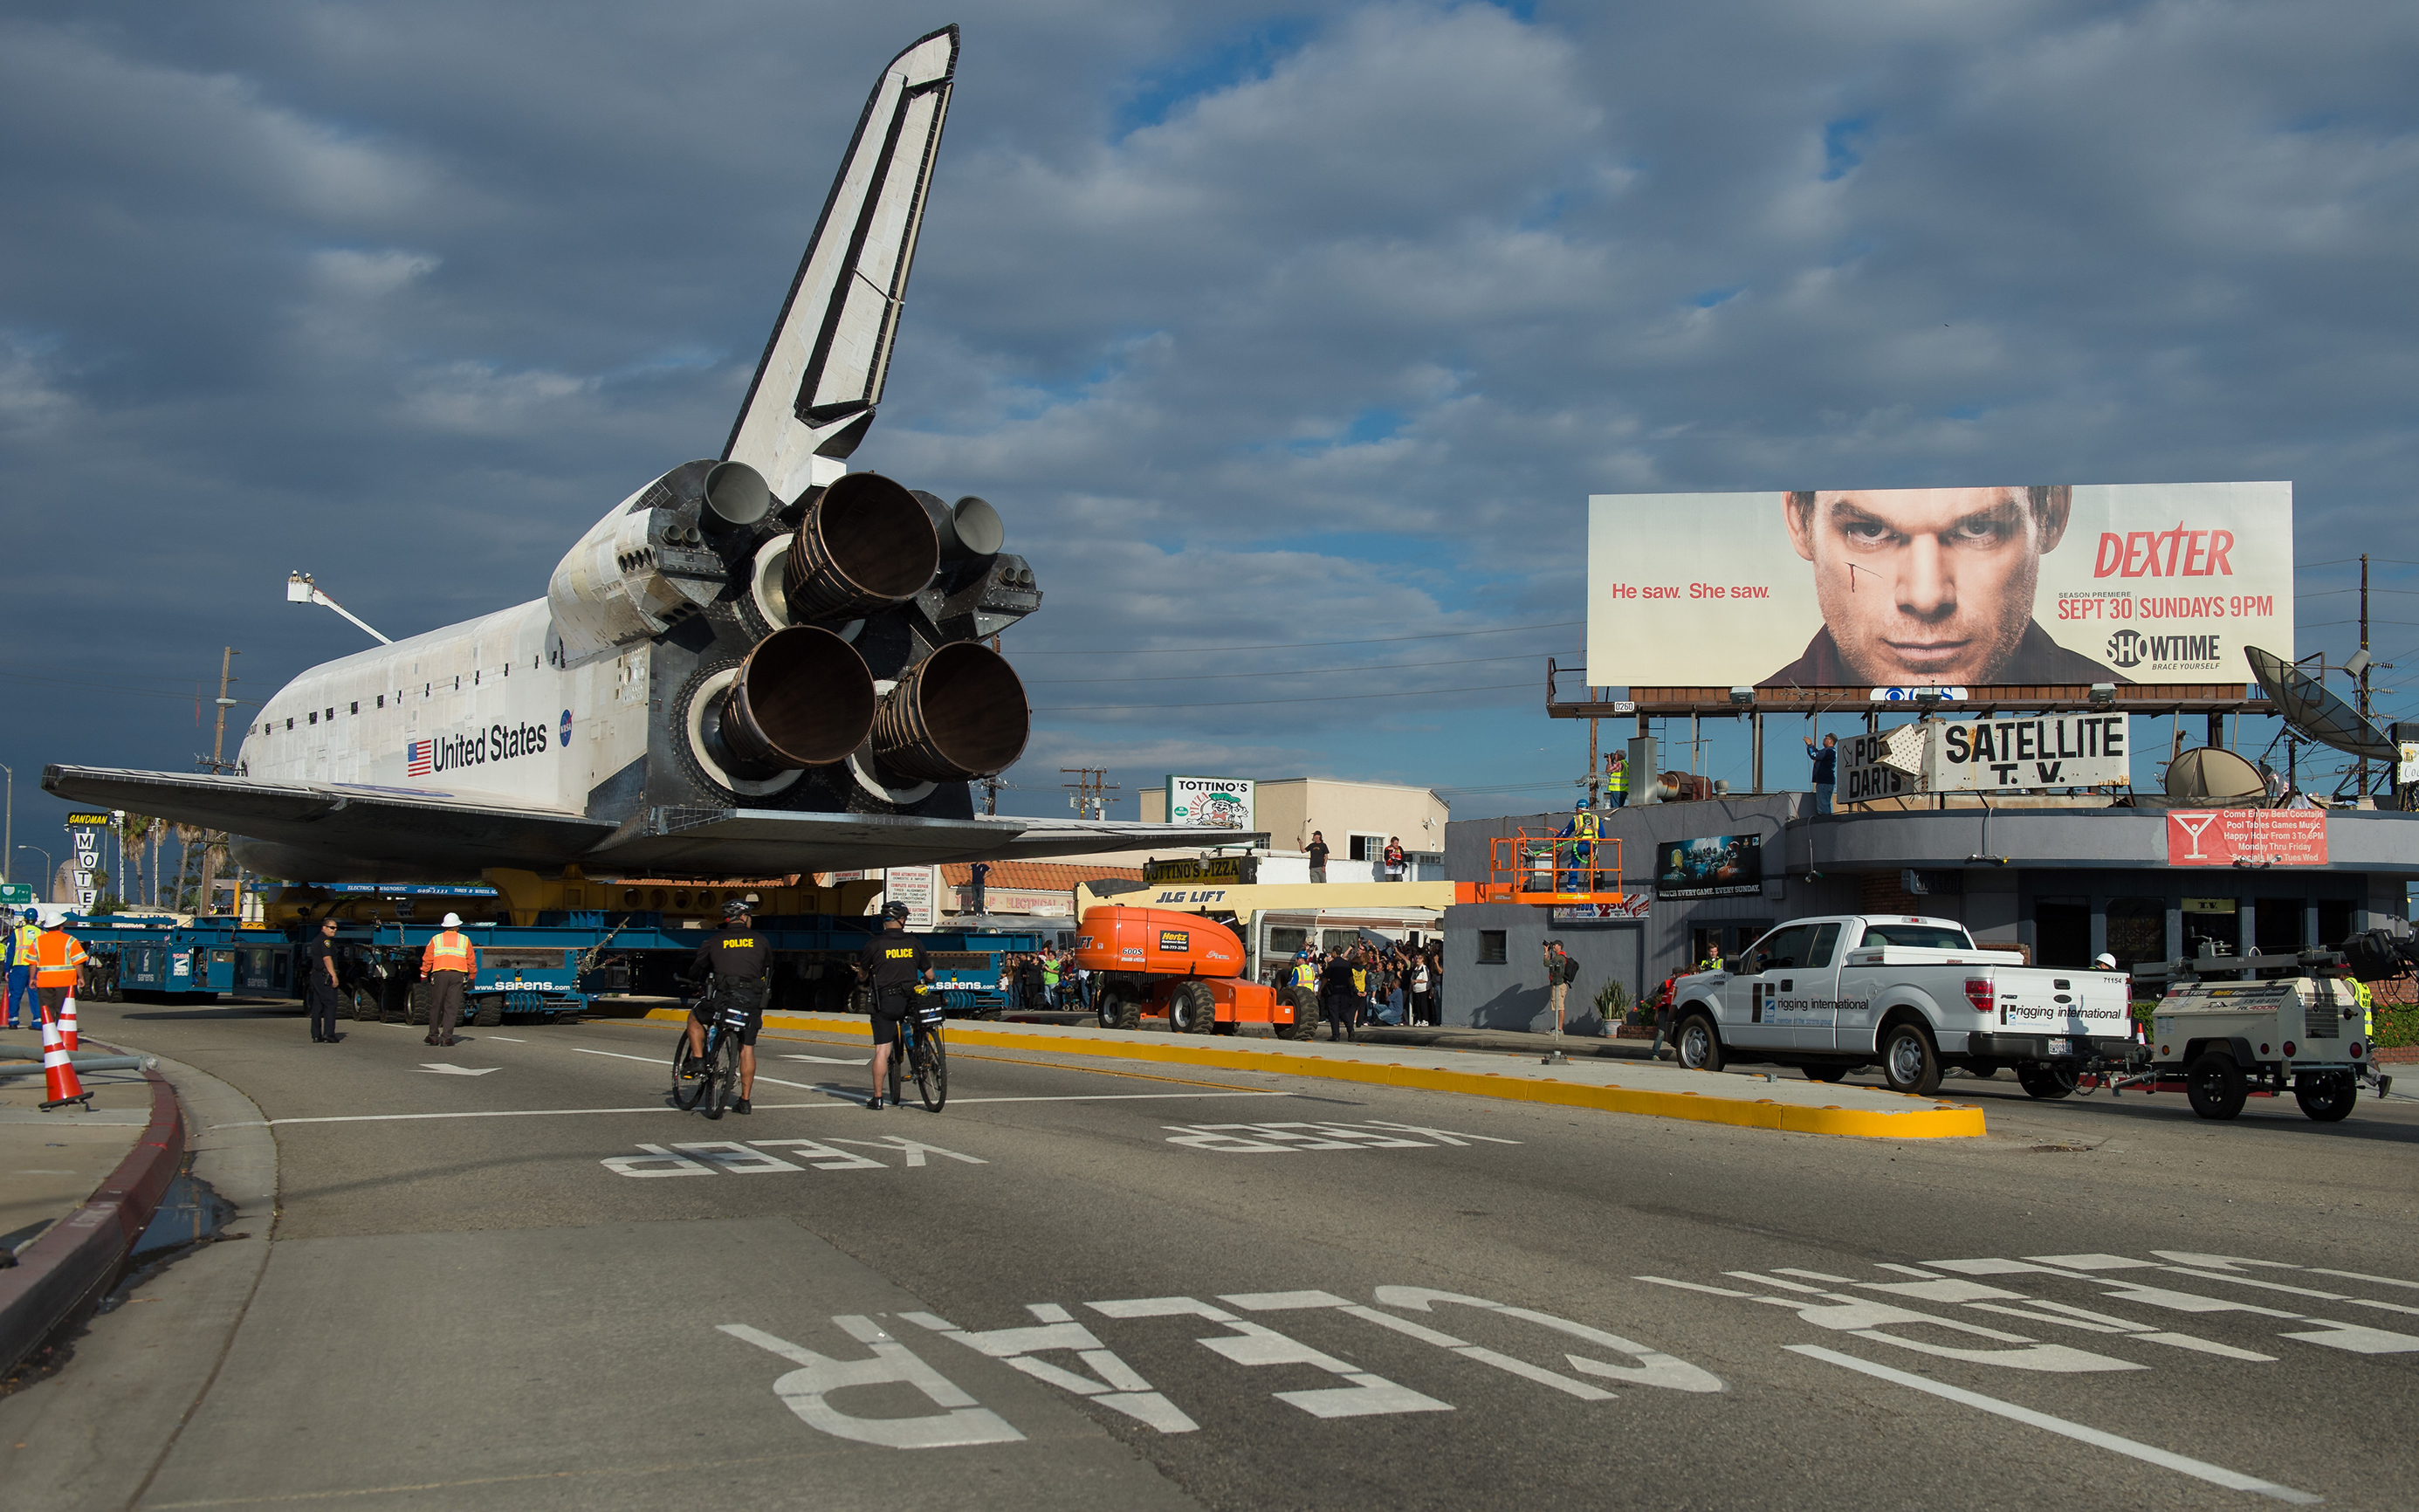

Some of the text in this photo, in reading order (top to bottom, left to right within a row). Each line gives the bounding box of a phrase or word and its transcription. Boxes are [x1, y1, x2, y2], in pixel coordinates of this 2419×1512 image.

[2093, 520, 2234, 578] DEXTER
[1612, 582, 1770, 599] He saw. She saw.
[2058, 595, 2273, 620] SEPT 30 SUNDAYS 9PM
[2106, 629, 2220, 668] SHOWTIME
[1615, 702, 1633, 711] 0260
[434, 721, 547, 773] United States
[1946, 717, 2124, 764] SATELLITE
[1179, 780, 1248, 793] TOTTINO'S
[1849, 769, 1902, 799] DARTS
[1190, 792, 1209, 816] PIZZA
[69, 814, 108, 825] SANDMAN
[2250, 810, 2270, 820] Enoy
[2223, 832, 2248, 842] Happy
[2238, 842, 2268, 852] Monday
[2290, 842, 2312, 852] Friday
[1715, 886, 1735, 895] EVERY
[1735, 884, 1760, 893] SUNDAY.
[1156, 890, 1226, 904] JLG LIFT
[1162, 932, 1187, 941] Hertz
[723, 938, 754, 949] POLICE
[885, 948, 913, 959] POLICE
[137, 973, 155, 982] sarens
[248, 978, 268, 987] sarens
[474, 981, 570, 991] www.sarens.com
[1777, 998, 1869, 1011] rigging international
[2016, 1006, 2121, 1020] rigging international
[1161, 1120, 1523, 1153] KEEP
[600, 1135, 989, 1178] KEEP
[715, 1286, 1723, 1449] CLEAR
